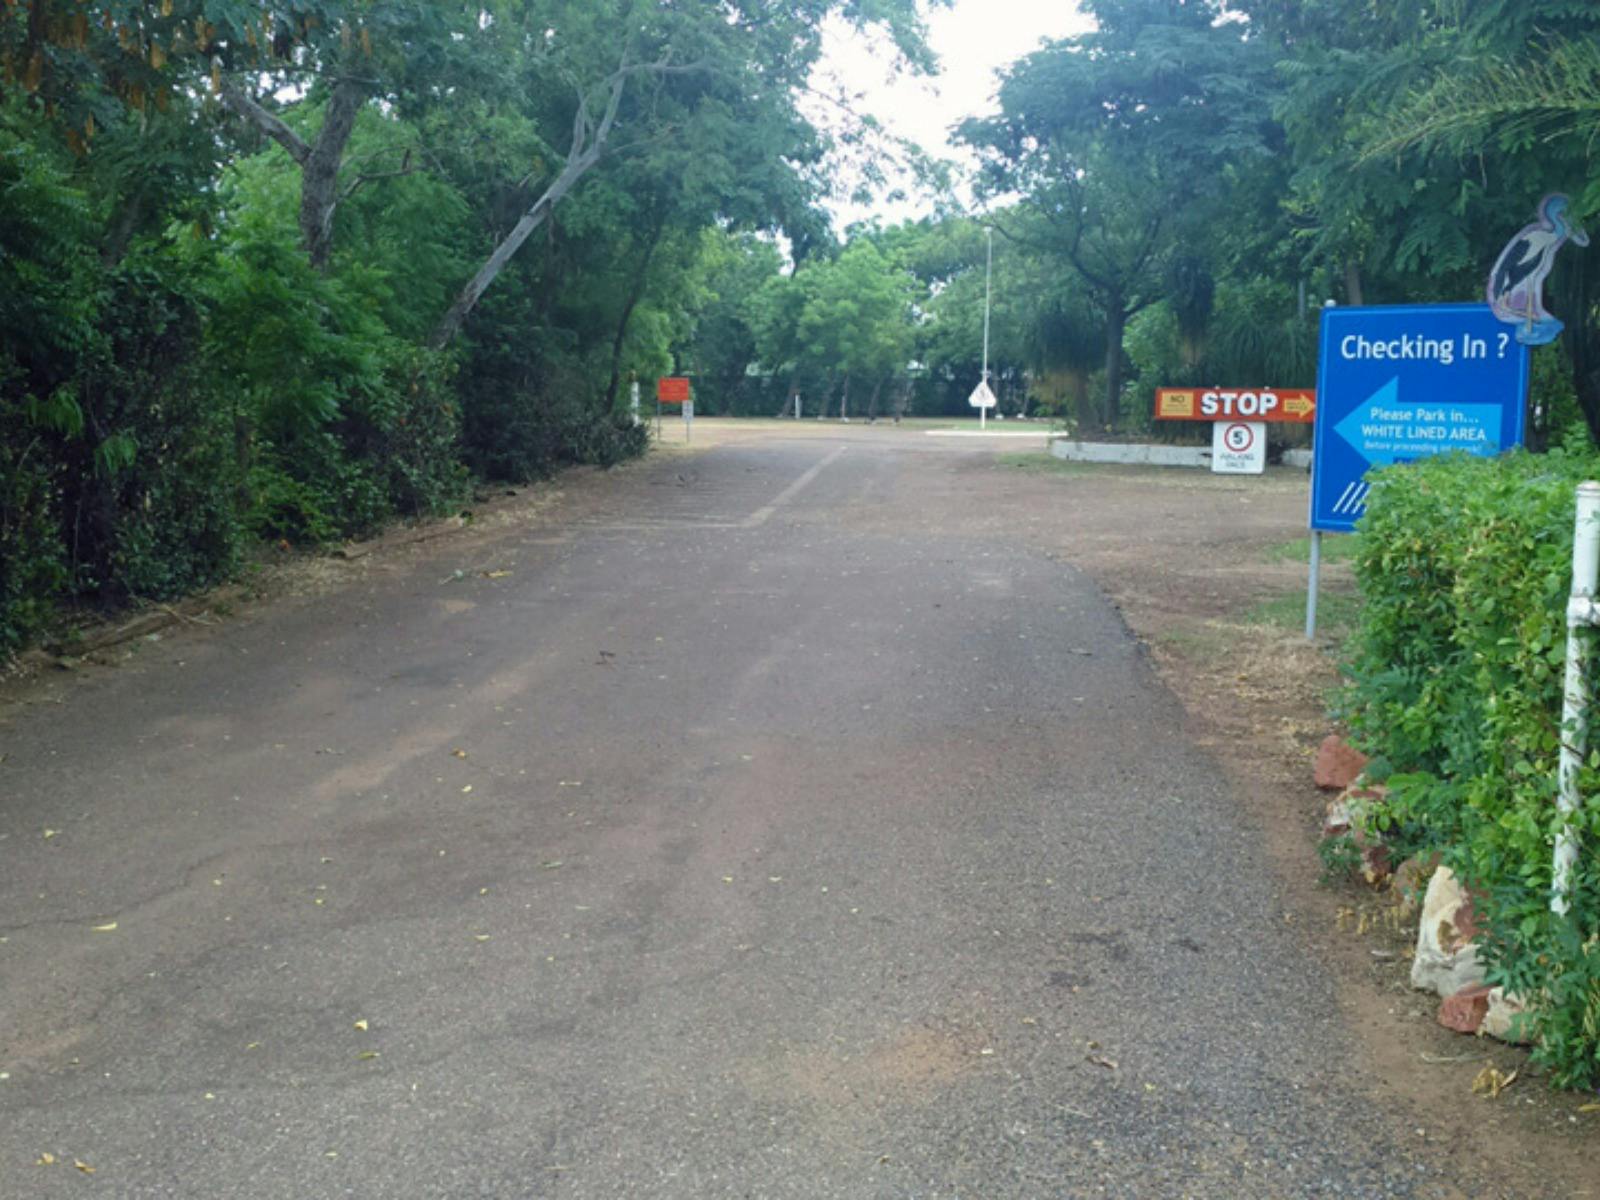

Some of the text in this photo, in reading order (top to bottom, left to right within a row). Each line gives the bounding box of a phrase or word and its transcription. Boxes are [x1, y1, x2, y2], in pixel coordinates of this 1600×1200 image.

[1341, 332, 1510, 365] Checking In ?
[1170, 394, 1185, 403] NO
[1201, 391, 1279, 416] STOP
[1371, 406, 1413, 420] Please
[1416, 408, 1446, 421] Park
[1233, 430, 1244, 445] 5
[1361, 423, 1487, 440] WHITE LINED AREA
